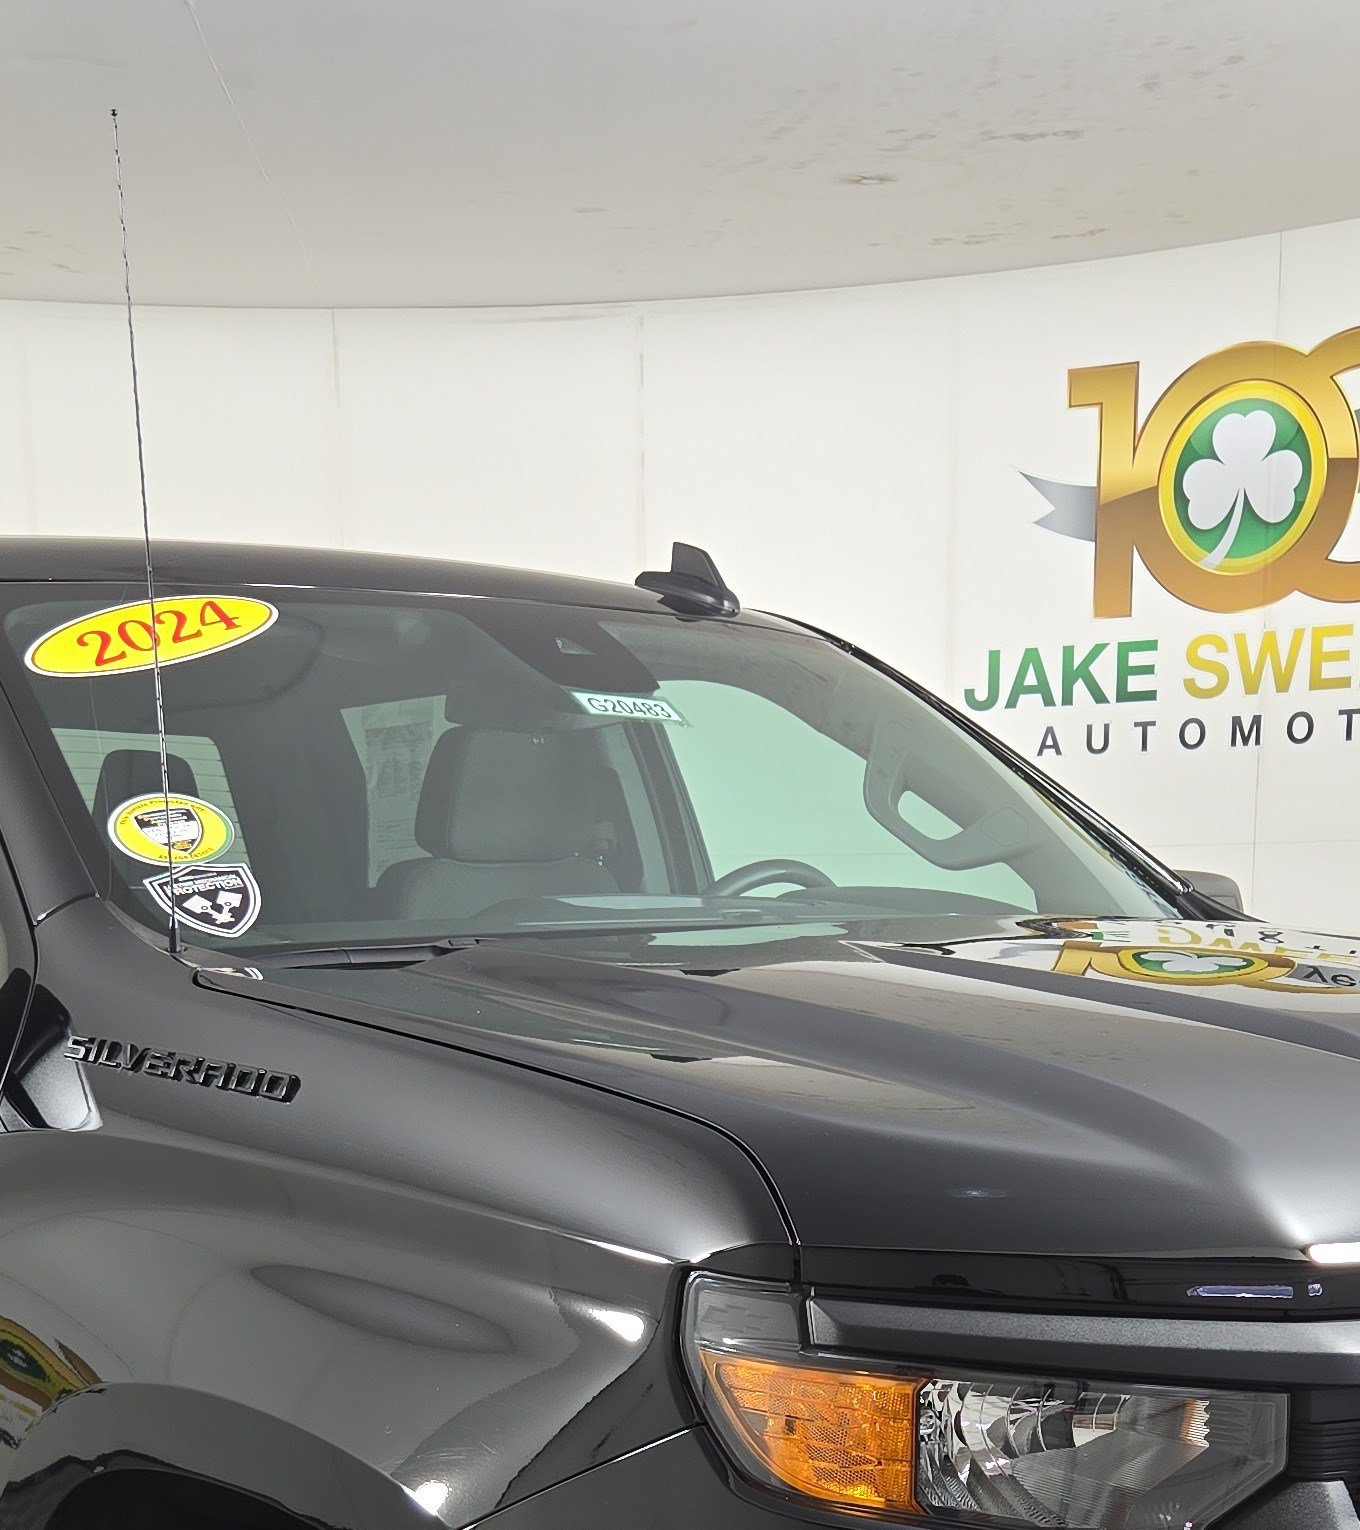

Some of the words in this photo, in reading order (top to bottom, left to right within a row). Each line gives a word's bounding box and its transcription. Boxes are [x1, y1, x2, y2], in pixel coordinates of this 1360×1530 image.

[76, 600, 242, 668] 2024
[587, 697, 674, 720] G20483
[963, 638, 1159, 713] JAKE
[63, 1035, 301, 1104] SILVERADO
